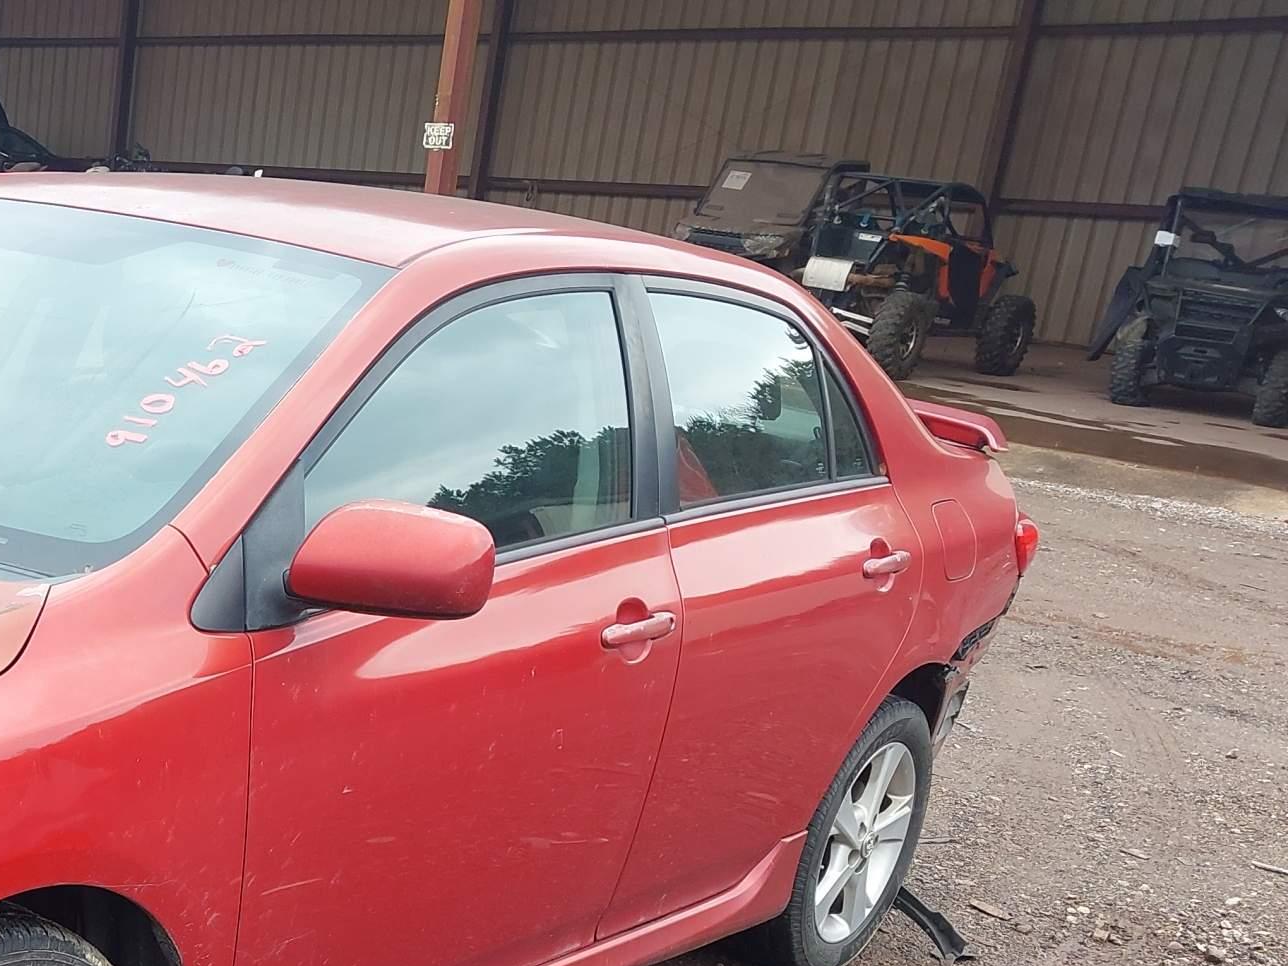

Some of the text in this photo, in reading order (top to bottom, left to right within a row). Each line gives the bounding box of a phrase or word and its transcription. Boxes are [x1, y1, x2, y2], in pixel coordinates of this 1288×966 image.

[427, 125, 451, 136] KEEP
[428, 136, 448, 145] OUT
[104, 335, 268, 447] 910462
